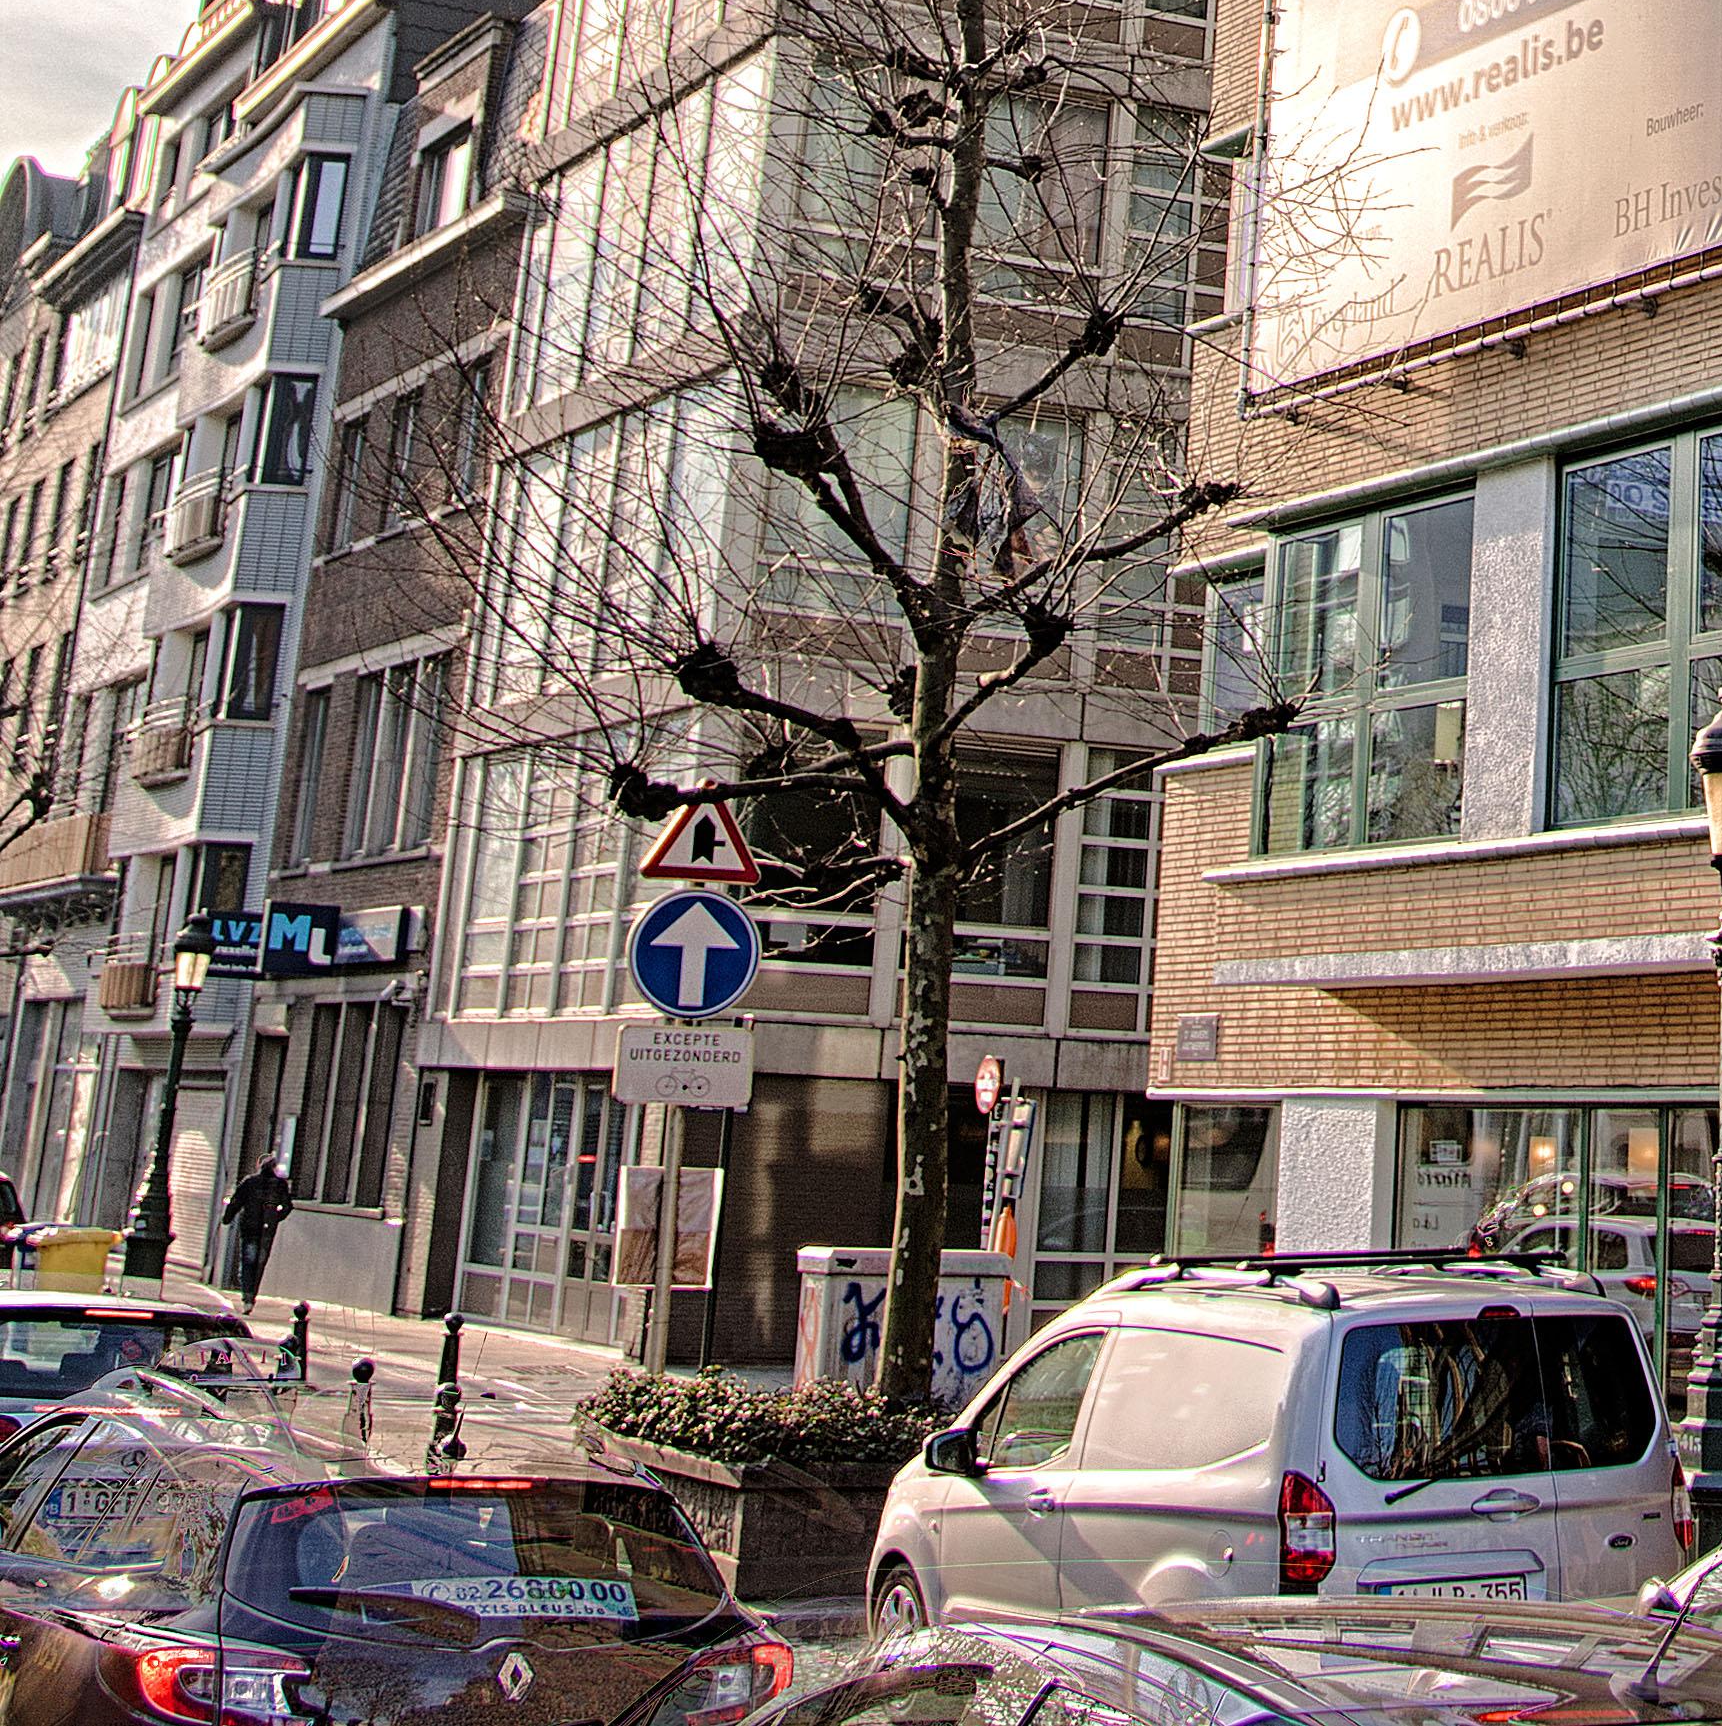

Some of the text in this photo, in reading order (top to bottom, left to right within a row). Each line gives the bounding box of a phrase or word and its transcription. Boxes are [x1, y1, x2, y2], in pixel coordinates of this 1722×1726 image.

[1391, 18, 1604, 133] www.realis.be
[1646, 102, 1704, 137] Bouwheer:
[1613, 187, 1653, 239] BH
[629, 1048, 742, 1064] UITGEZONDERD
[653, 1032, 722, 1047] EXCEPTE
